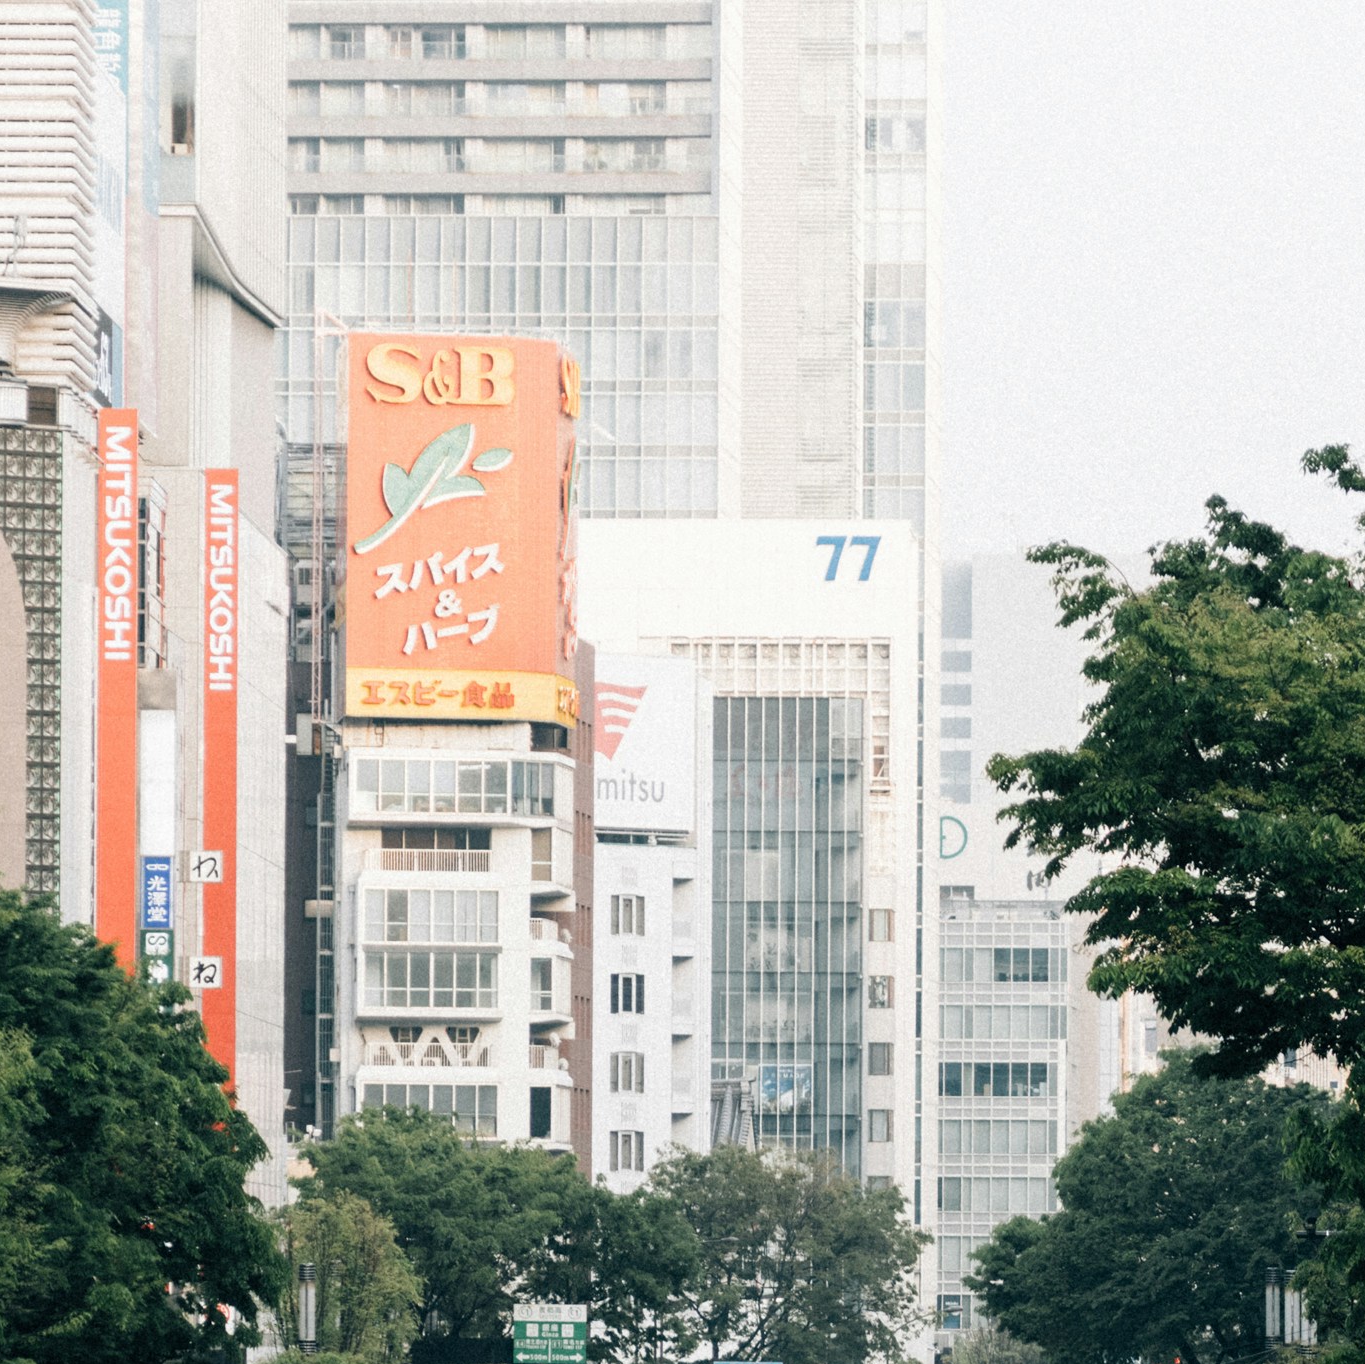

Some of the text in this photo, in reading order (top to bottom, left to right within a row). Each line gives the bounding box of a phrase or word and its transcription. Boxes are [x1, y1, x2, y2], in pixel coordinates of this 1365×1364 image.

[367, 343, 516, 405] S&B
[104, 426, 133, 661] MITSUKOSHI
[816, 535, 882, 581] 77
[209, 484, 234, 691] MITSUKOSHI
[374, 543, 504, 599] スパイス
[402, 603, 500, 656] ハーブ
[435, 589, 463, 619] &
[360, 680, 516, 710] エスビー食品
